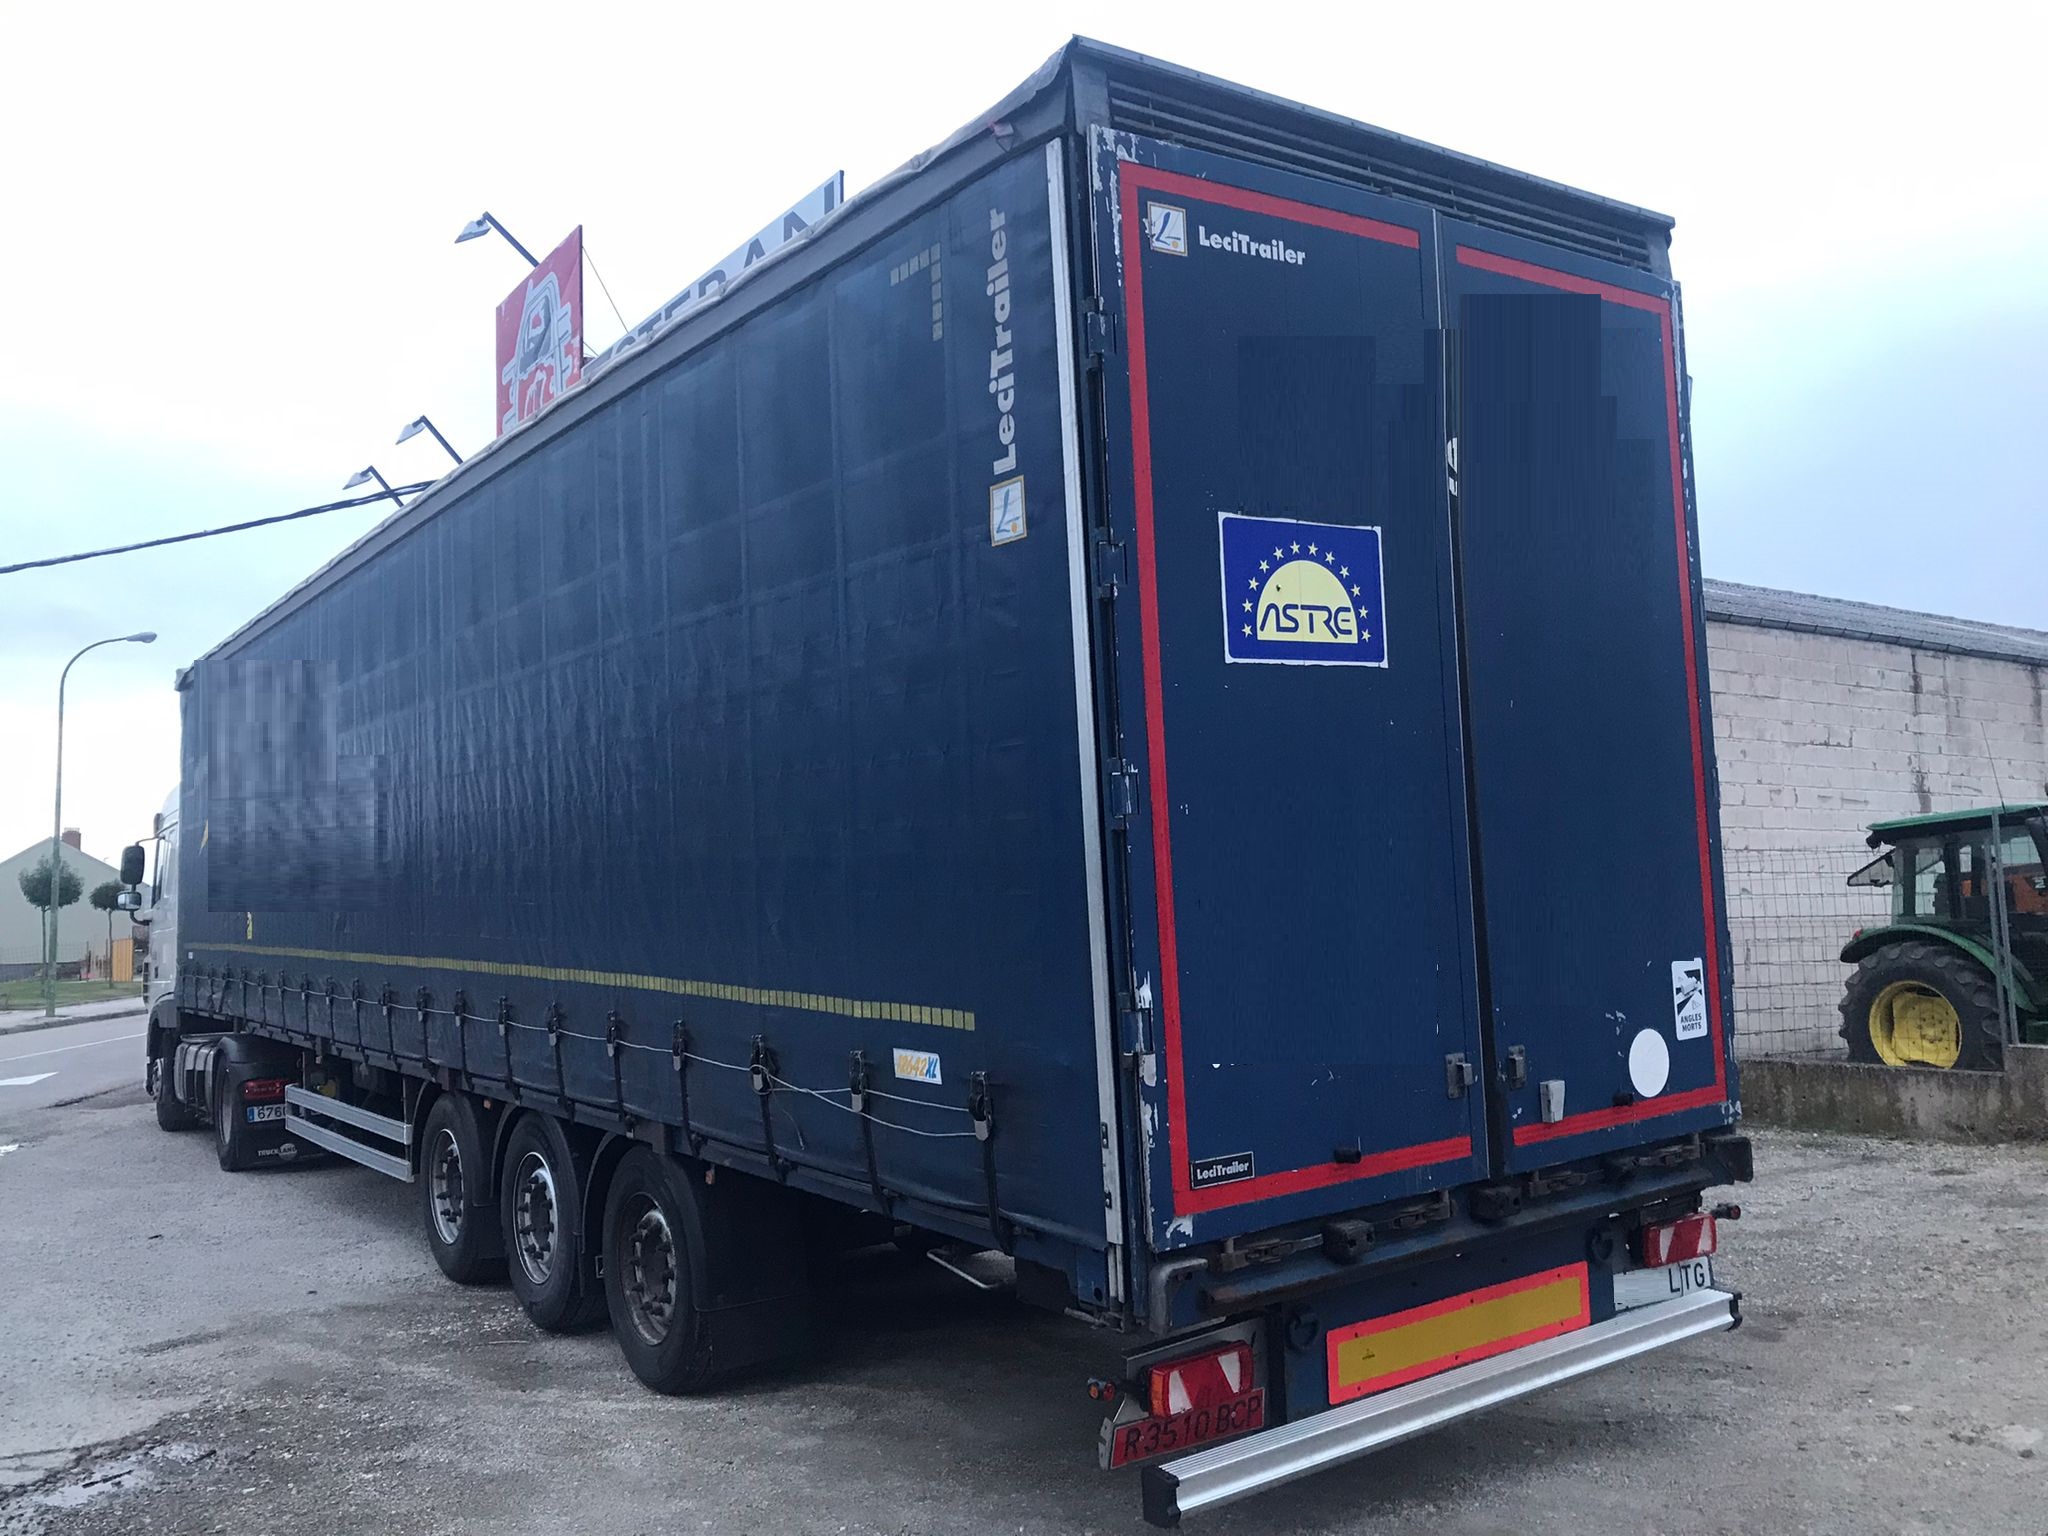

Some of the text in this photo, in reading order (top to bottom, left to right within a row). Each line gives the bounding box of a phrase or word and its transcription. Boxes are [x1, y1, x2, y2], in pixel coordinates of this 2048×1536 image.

[1198, 225, 1306, 265] LeciTrailer
[986, 208, 1017, 475] LeciTrailer
[1259, 603, 1353, 639] ASTRE
[1680, 1013, 1702, 1023] ANGLES
[1682, 1022, 1702, 1032] MORTS
[1196, 1161, 1250, 1180] LeciTrailer
